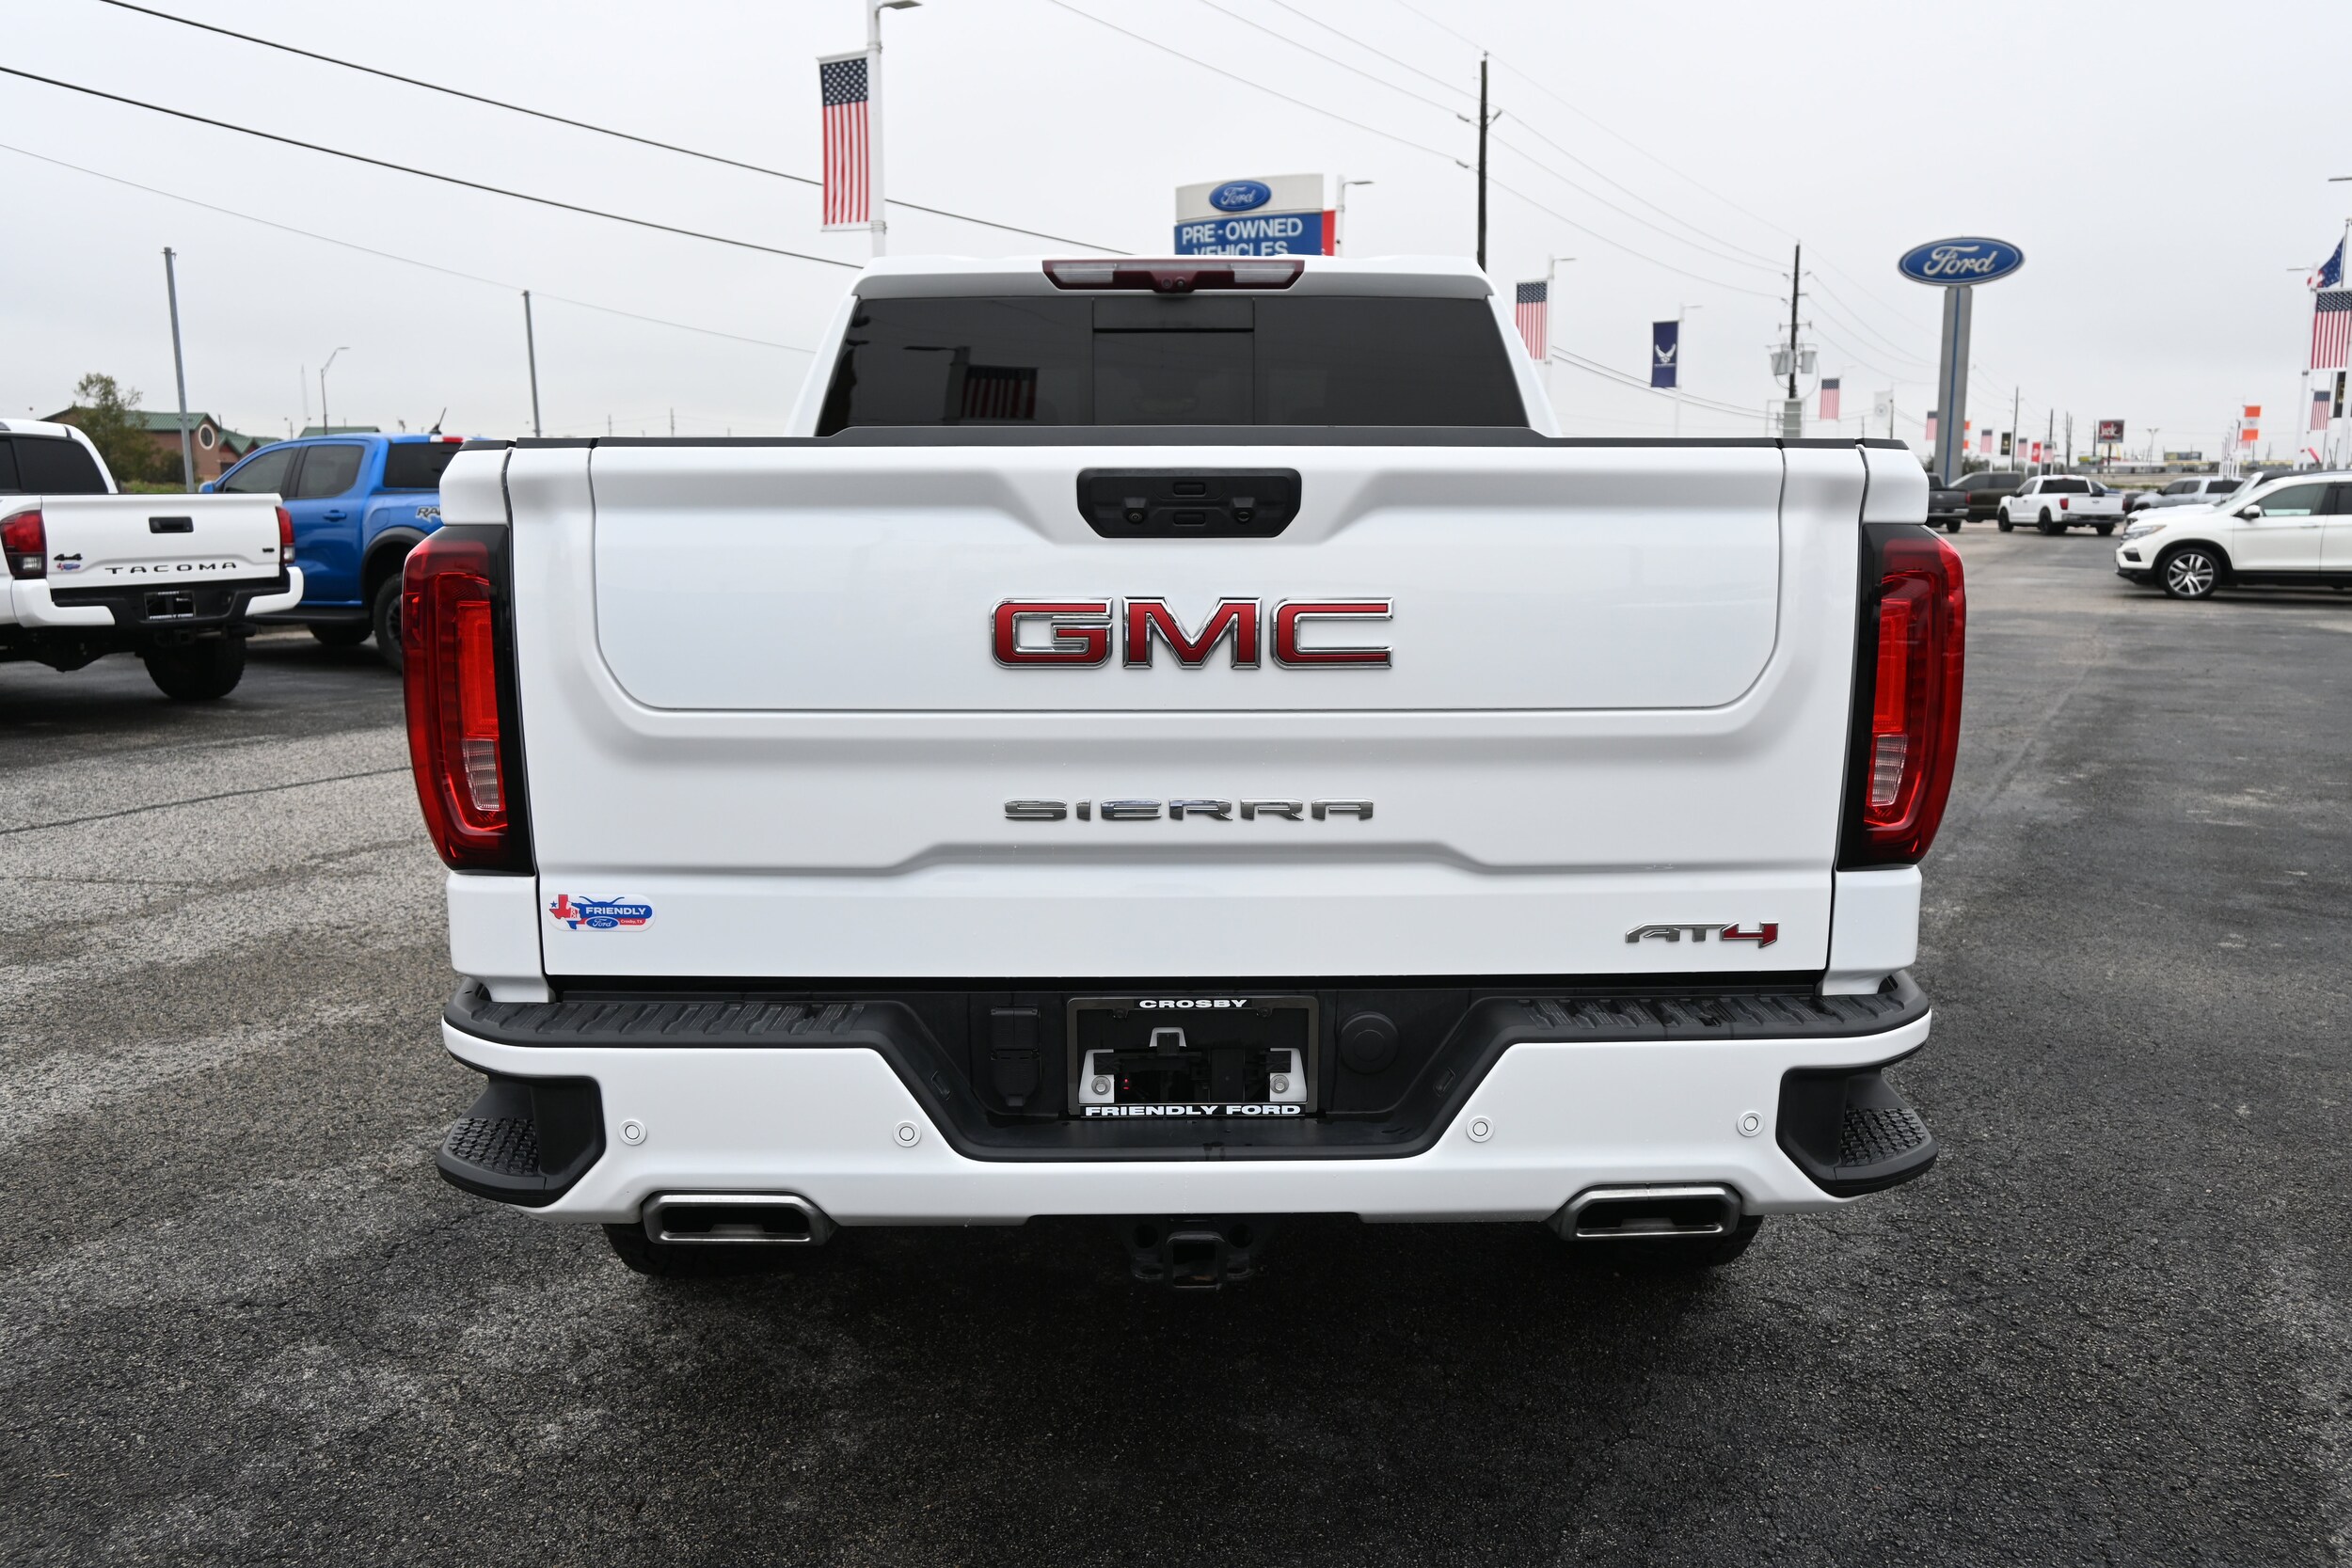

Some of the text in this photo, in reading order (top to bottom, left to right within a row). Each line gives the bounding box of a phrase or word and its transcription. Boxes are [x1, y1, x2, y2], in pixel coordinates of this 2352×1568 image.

[1220, 186, 1256, 205] Ford
[1923, 245, 1998, 277] Ford
[104, 562, 237, 575] TACOMA
[989, 596, 1394, 670] GMC
[1003, 798, 1375, 821] SIERRA
[585, 907, 646, 915] FRIENDLY
[592, 918, 612, 927] Ford
[1625, 921, 1779, 948] AT4
[1138, 999, 1248, 1008] CROSBY
[1085, 1103, 1302, 1117] FRIENDLY FORD
